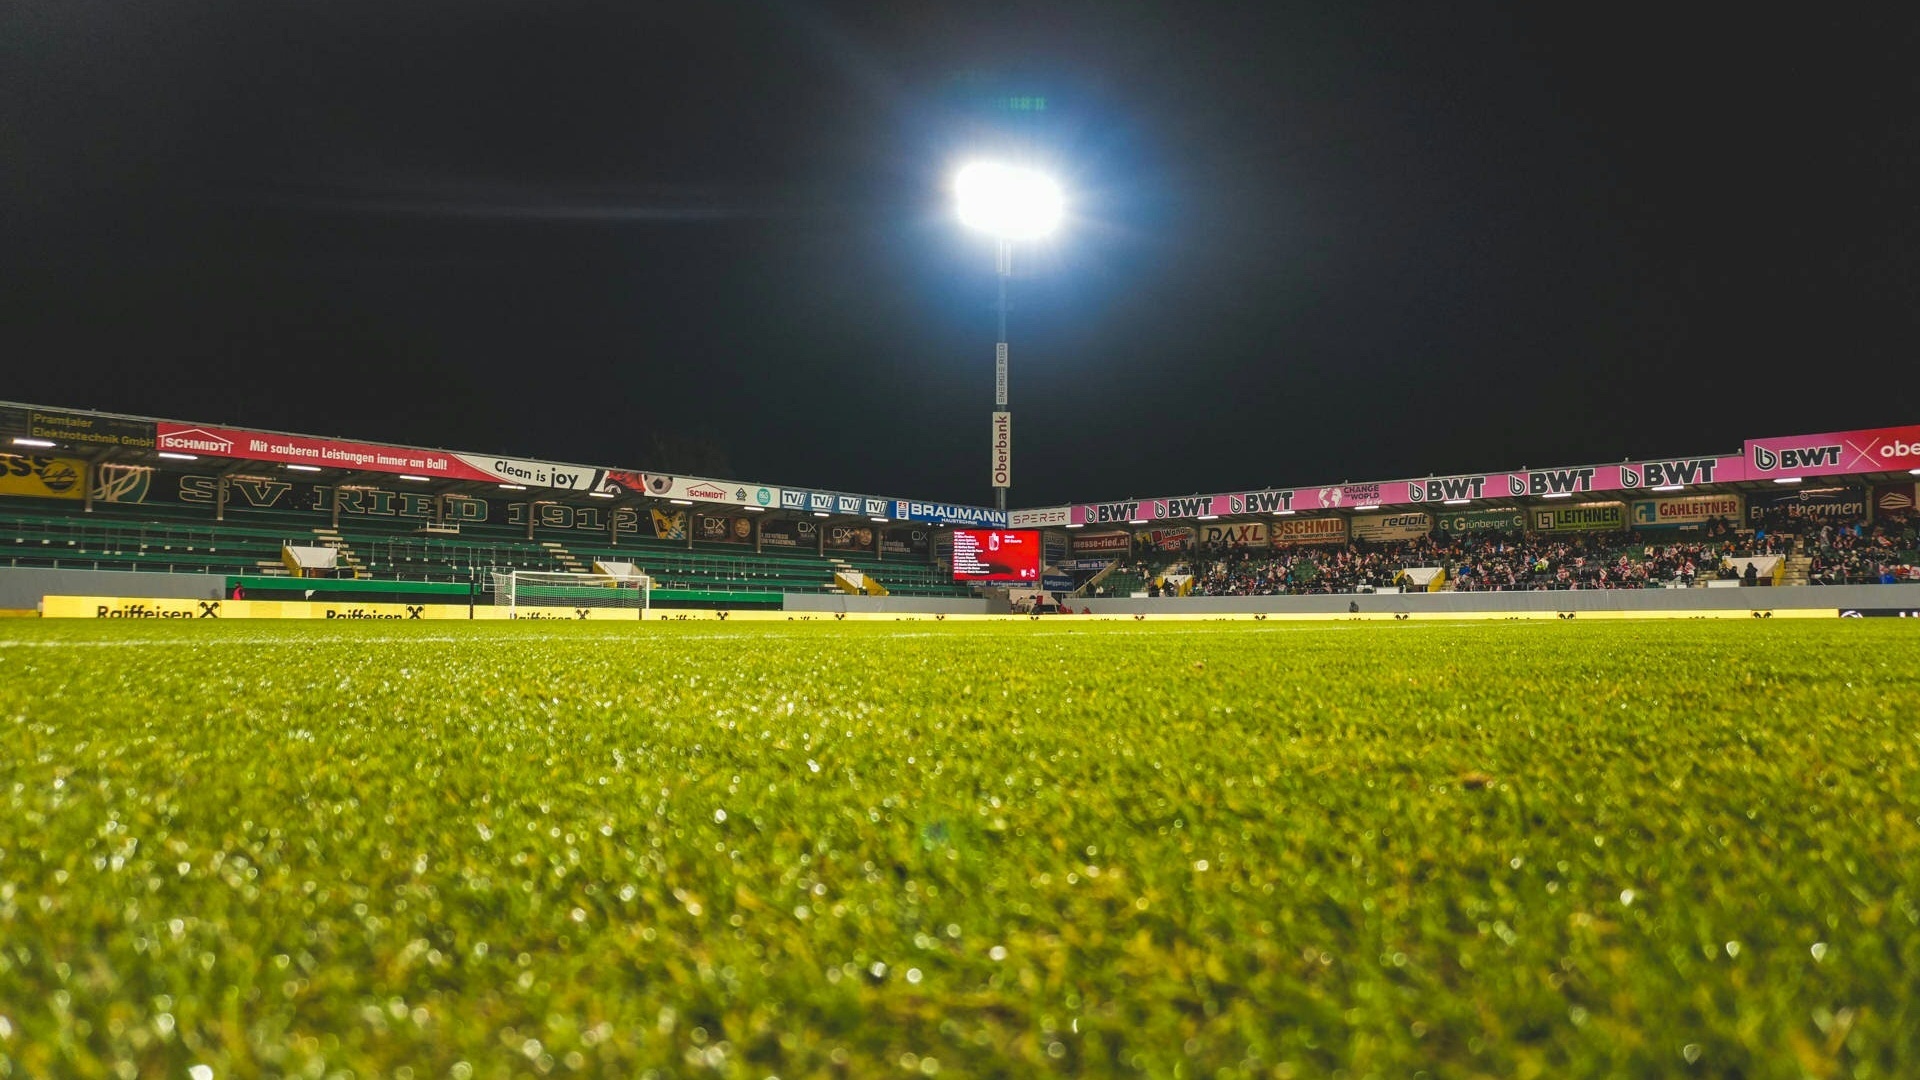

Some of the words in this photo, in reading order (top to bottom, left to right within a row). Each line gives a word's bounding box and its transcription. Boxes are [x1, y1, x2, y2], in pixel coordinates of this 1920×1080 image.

[32, 427, 118, 444] Elektrotechnik
[121, 435, 155, 447] GmbH
[165, 437, 228, 452] SCHMIDT
[250, 439, 268, 453] Mit
[271, 443, 319, 458] sauberen
[322, 447, 374, 465] Leistungen
[377, 453, 406, 466] immer
[410, 459, 424, 469] am
[427, 458, 447, 470] Ball!
[995, 416, 1007, 484] Oberbank
[1779, 445, 1842, 469] BWT
[494, 460, 532, 480] Clean
[536, 469, 546, 483] is
[551, 467, 579, 489] joy
[1529, 468, 1595, 494] BWT
[1642, 459, 1717, 487] BWT
[689, 489, 724, 500] SCHMIDT
[1343, 484, 1379, 494] CHANGE
[1351, 492, 1379, 500] WORLD
[1426, 477, 1485, 501] BWT
[179, 475, 292, 507] SV
[313, 485, 488, 522] RIED
[508, 503, 637, 533] 1912
[1098, 502, 1139, 522] BWT
[1168, 497, 1213, 518] BWT
[1245, 491, 1294, 513] BWT
[911, 503, 1006, 523] BRAUMANN
[1013, 511, 1066, 524] SPERER
[1557, 507, 1619, 524] LEITHNER
[97, 605, 193, 619] Raiffeisen
